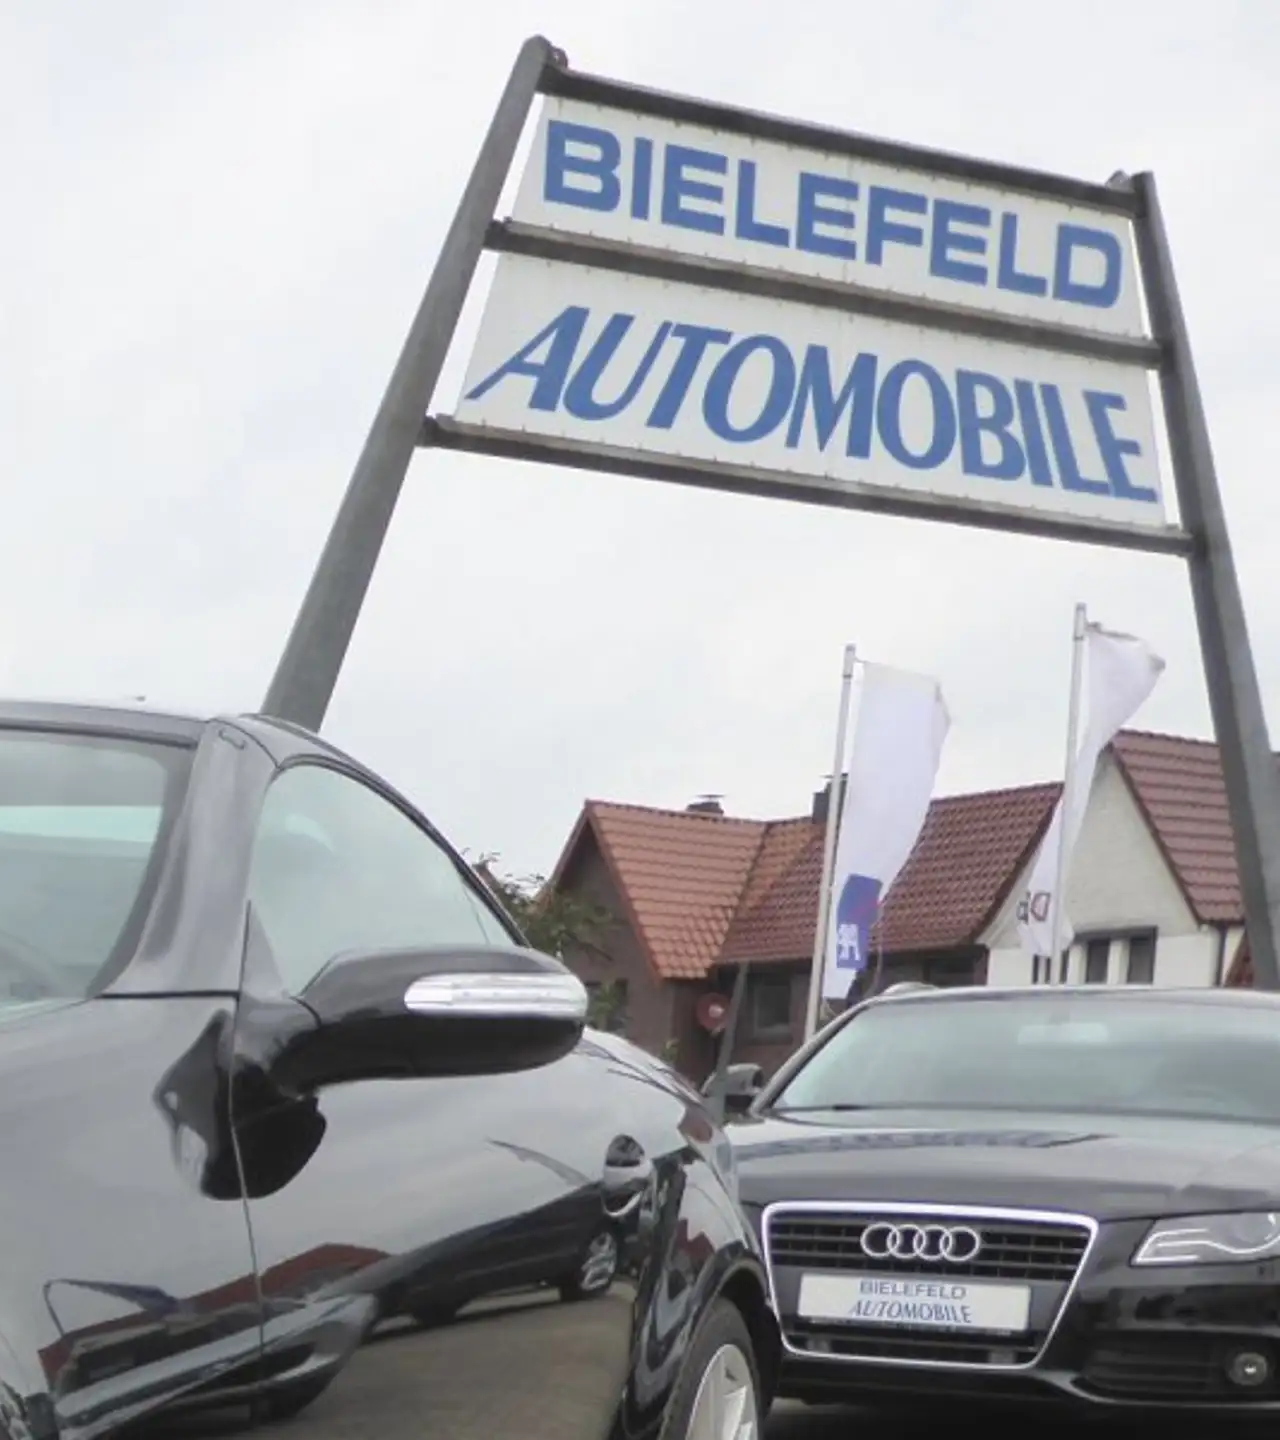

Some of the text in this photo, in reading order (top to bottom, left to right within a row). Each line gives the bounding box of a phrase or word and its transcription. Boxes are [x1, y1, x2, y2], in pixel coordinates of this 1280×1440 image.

[542, 119, 1125, 310] BIELEFELD
[466, 305, 1159, 504] AUTOMOBILE
[851, 1299, 973, 1324] AUTOMOBILE
[859, 1280, 967, 1300] BIELEFELD
